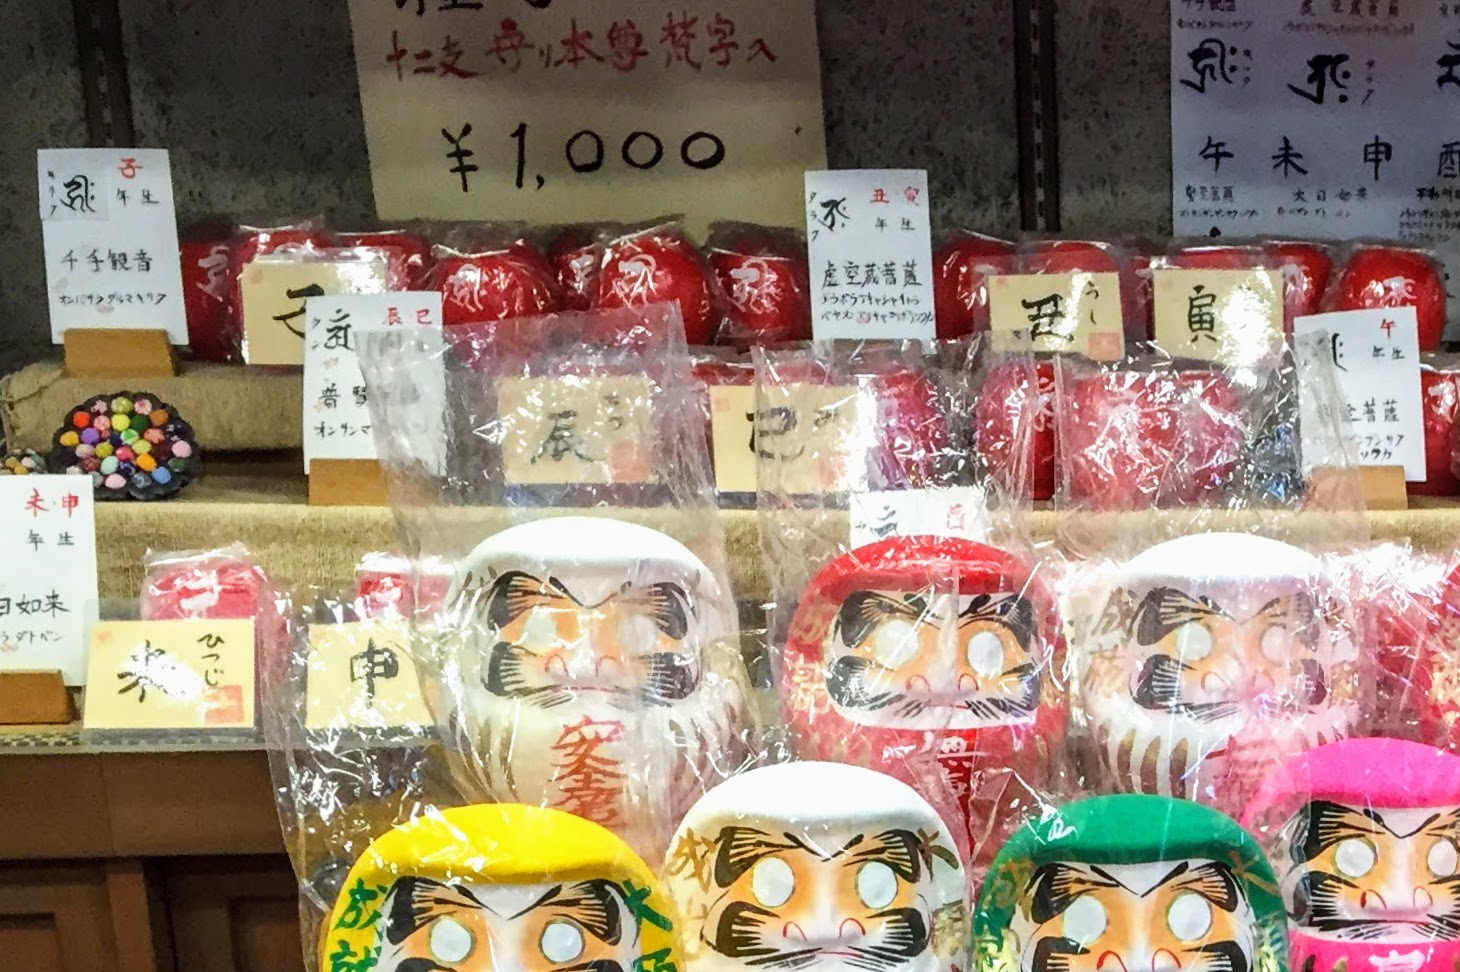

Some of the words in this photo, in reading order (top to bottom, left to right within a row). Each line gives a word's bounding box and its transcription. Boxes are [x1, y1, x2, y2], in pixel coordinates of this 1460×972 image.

[118, 157, 144, 180] 子
[441, 122, 726, 192] ¥1,000
[1199, 135, 1235, 174] 午
[1271, 135, 1308, 178] 未
[1363, 134, 1392, 181] 申
[60, 249, 153, 273] 千手観音
[1187, 285, 1218, 343] 寅
[1380, 318, 1396, 339] 午
